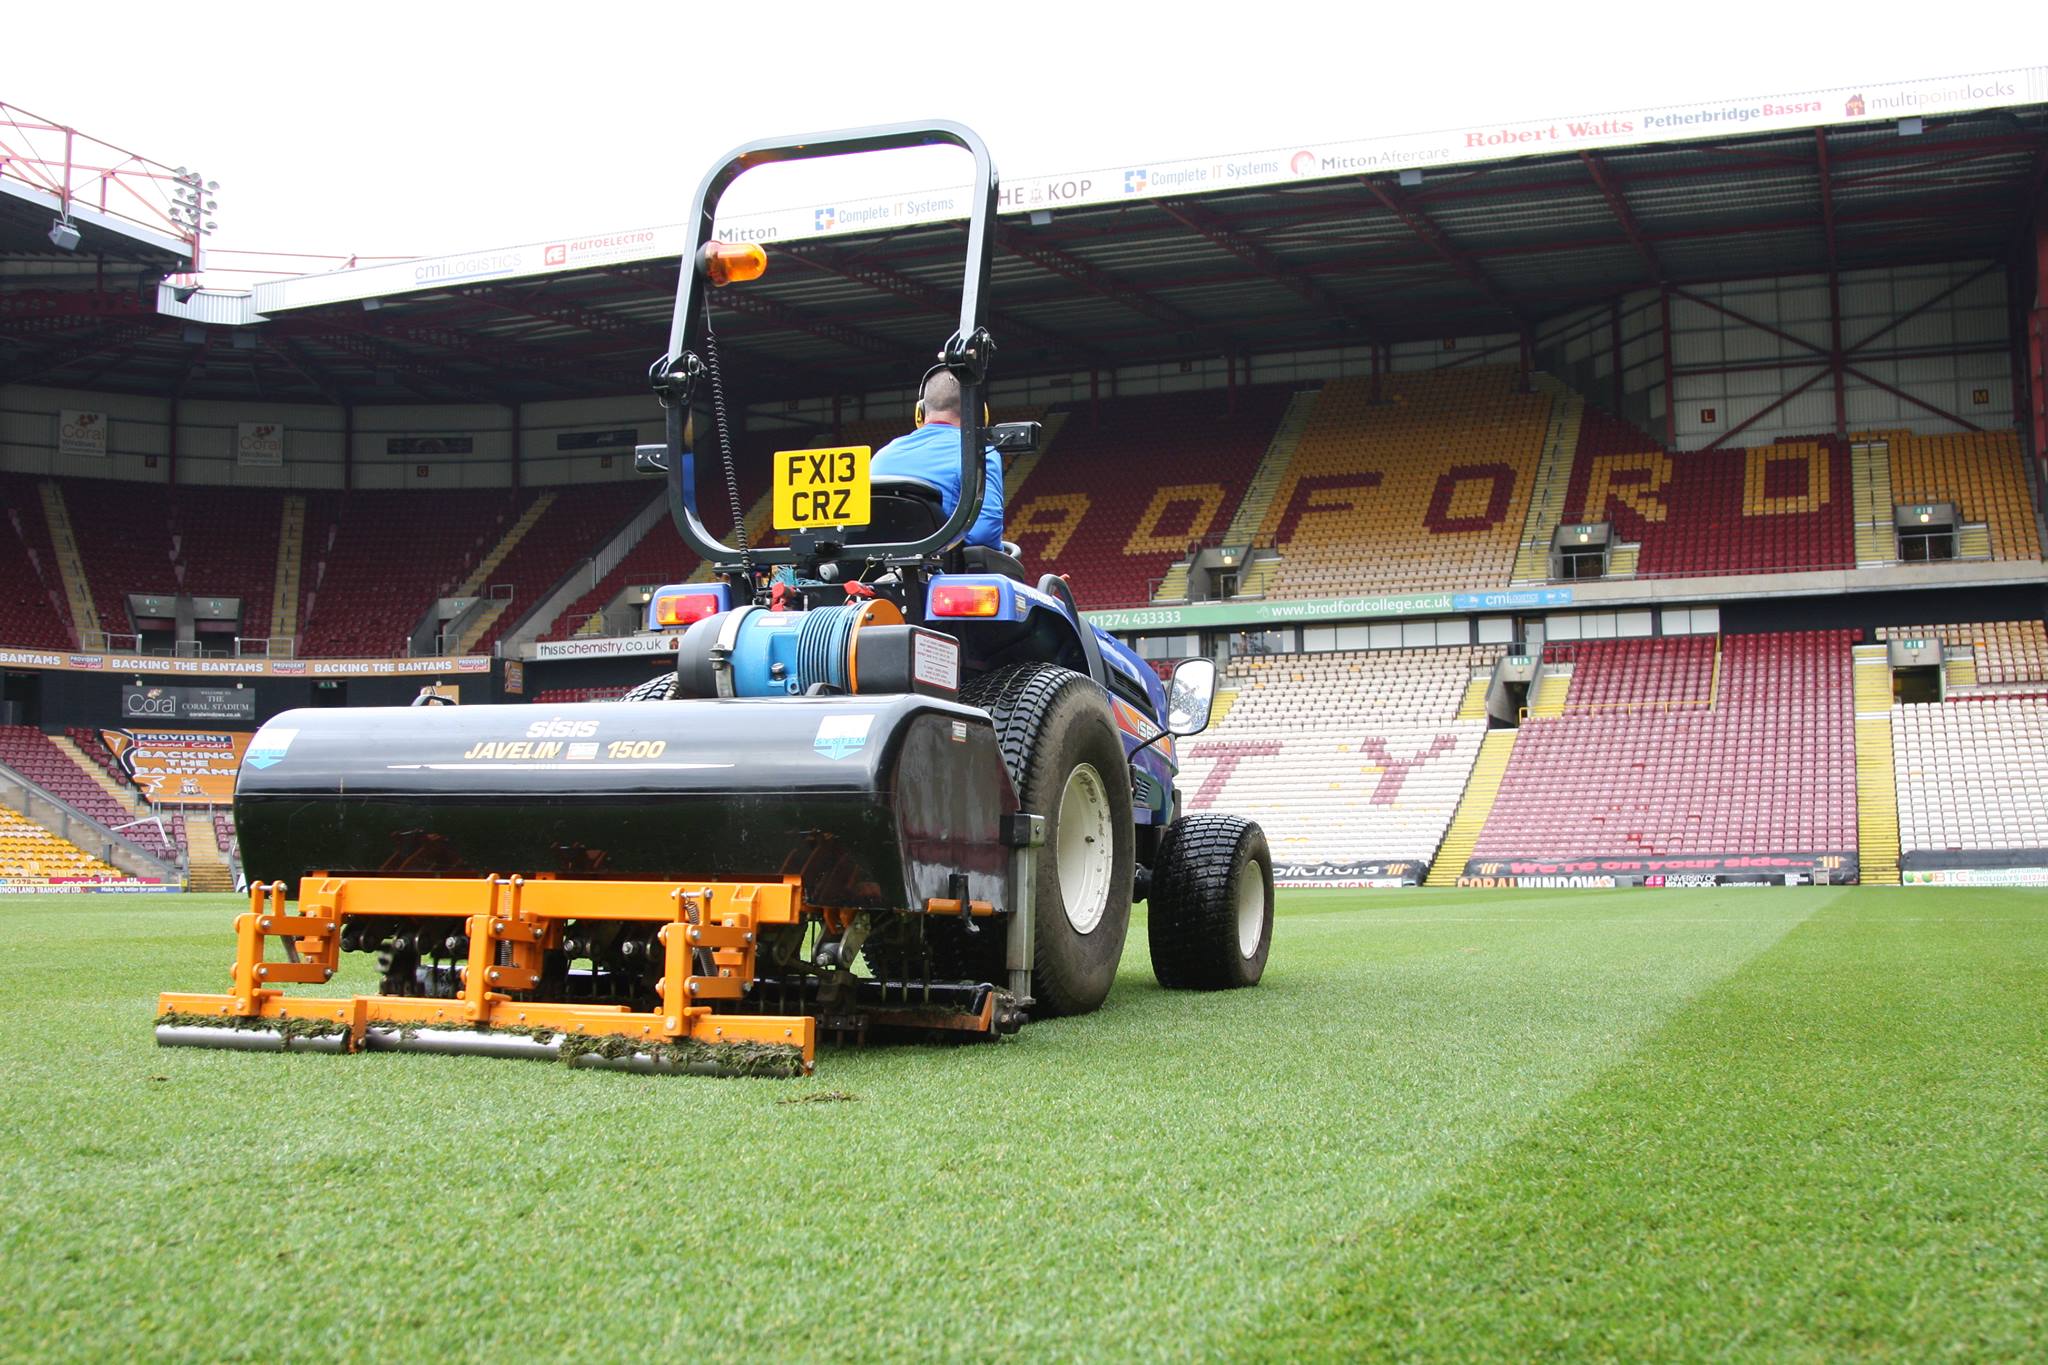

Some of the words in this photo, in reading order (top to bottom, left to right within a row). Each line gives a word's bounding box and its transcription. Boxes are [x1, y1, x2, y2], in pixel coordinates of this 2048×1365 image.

[1464, 124, 1560, 148] Robert
[1566, 119, 1634, 138] Watts
[1151, 168, 1207, 187] Complete
[1212, 165, 1223, 179] IT
[1226, 160, 1279, 178] Systems
[1048, 179, 1092, 201] KOP
[839, 206, 889, 225] Complete
[894, 202, 904, 216] IT
[907, 198, 954, 216] Systems
[570, 231, 654, 252] AUTOELECTRO
[718, 225, 777, 243] Mitton
[1975, 391, 1986, 402] M
[1704, 409, 1713, 421] L
[788, 452, 855, 486] FX13
[792, 489, 851, 521] CRZ
[1271, 596, 1450, 617] www.bradfordcollege.ac.uk
[1088, 613, 1129, 626] 01274
[1133, 611, 1181, 625] 433333
[540, 638, 662, 657] thisischemistry.co.uk
[0, 653, 61, 665] BANTAMS
[112, 659, 170, 670] BACKING
[174, 661, 197, 671] THE
[202, 661, 263, 673] BANTAMS
[314, 663, 369, 673] BACKING
[372, 662, 394, 672] THE
[398, 660, 452, 671] BANTAMS
[128, 693, 176, 713] Coral
[212, 703, 249, 711] STADIUM
[137, 734, 227, 742] PROVIDENT
[137, 750, 234, 760] BACKING
[464, 741, 564, 760] JAVELIN
[607, 740, 666, 759] 1500
[165, 759, 209, 767] THE
[1510, 861, 1598, 874] We're
[1600, 861, 1641, 871] on
[1646, 859, 1720, 871] your
[1935, 871, 1968, 882] BTC
